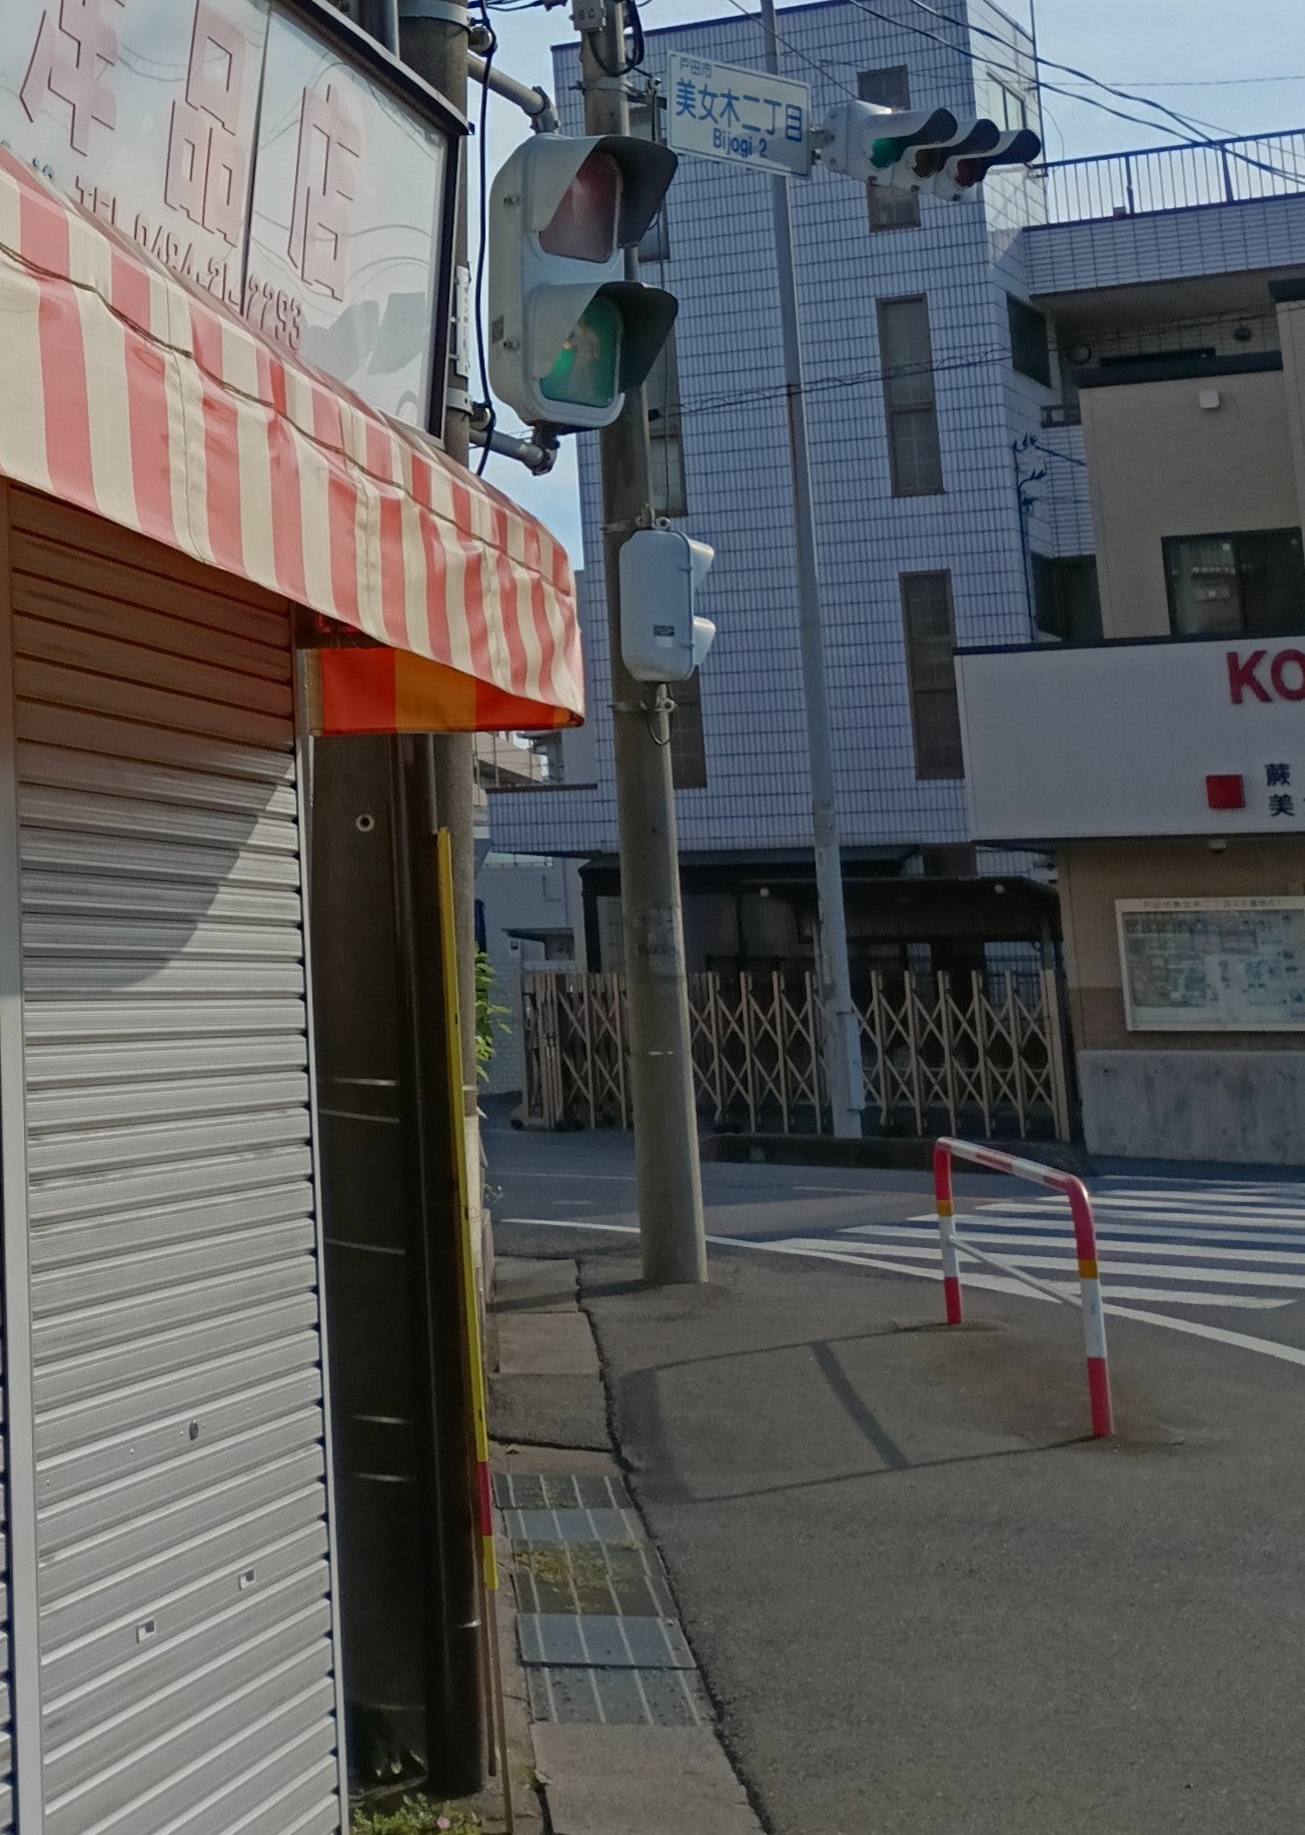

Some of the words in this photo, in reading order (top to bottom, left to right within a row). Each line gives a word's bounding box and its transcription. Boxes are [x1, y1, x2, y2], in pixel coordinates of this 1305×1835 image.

[676, 77, 802, 143] 美女木二丁目
[713, 127, 753, 159] Bijogi
[758, 137, 768, 159] 2
[1226, 648, 1305, 705] KO
[1267, 793, 1305, 817] 美
